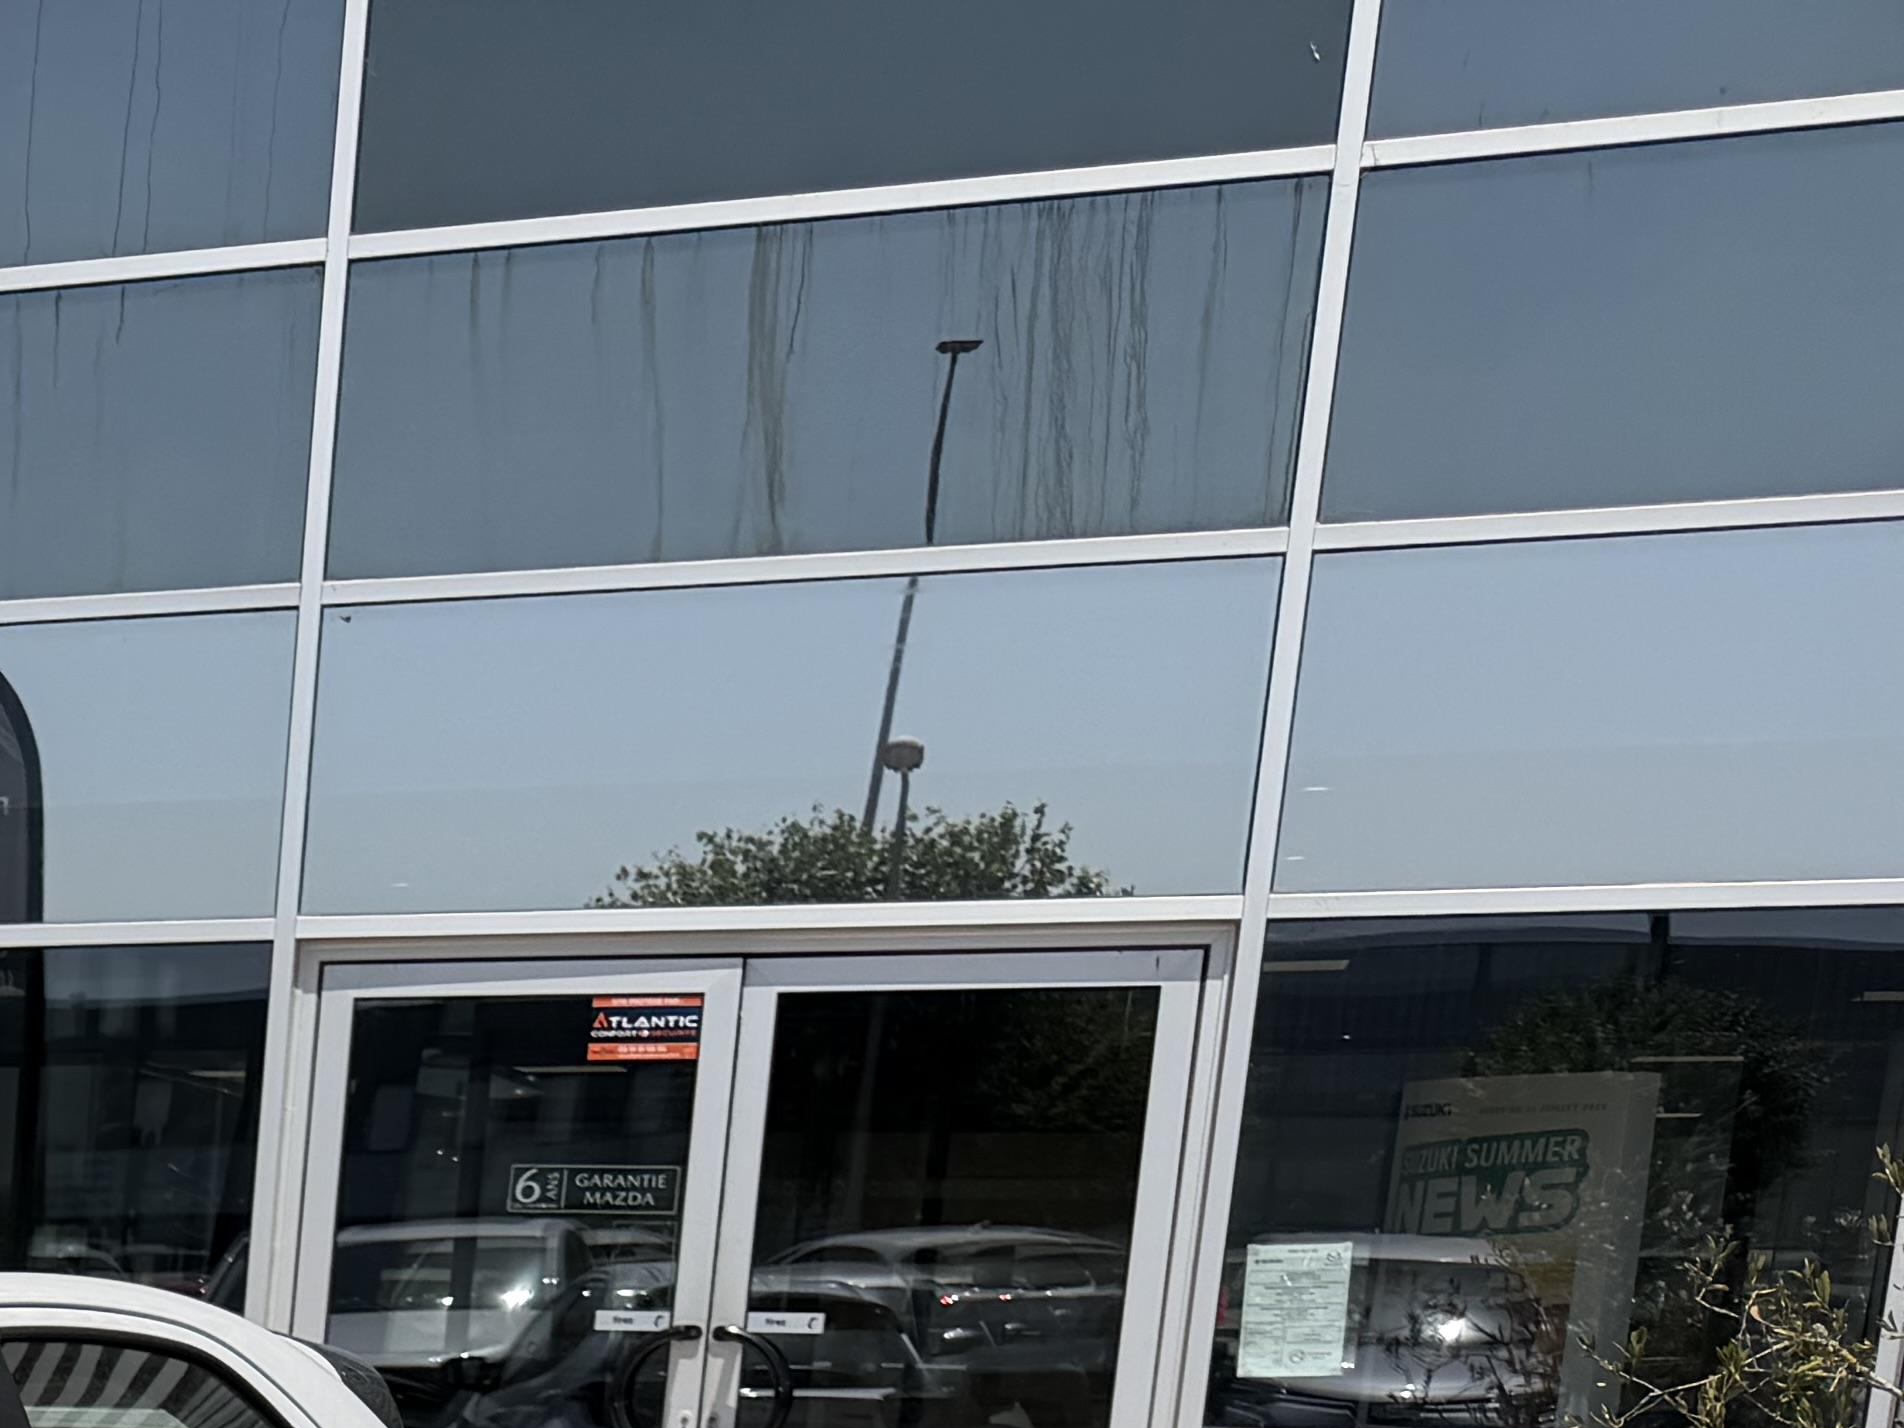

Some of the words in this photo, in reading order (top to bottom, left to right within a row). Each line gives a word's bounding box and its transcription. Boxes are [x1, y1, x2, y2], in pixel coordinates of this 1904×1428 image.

[592, 1011, 699, 1029] ATLANTIC
[1464, 1135, 1582, 1169] SUMMER
[515, 1168, 542, 1203] 6
[575, 1173, 668, 1189] GARANTIE
[583, 1191, 656, 1207] MAZDA
[1394, 1167, 1578, 1234] NEWS
